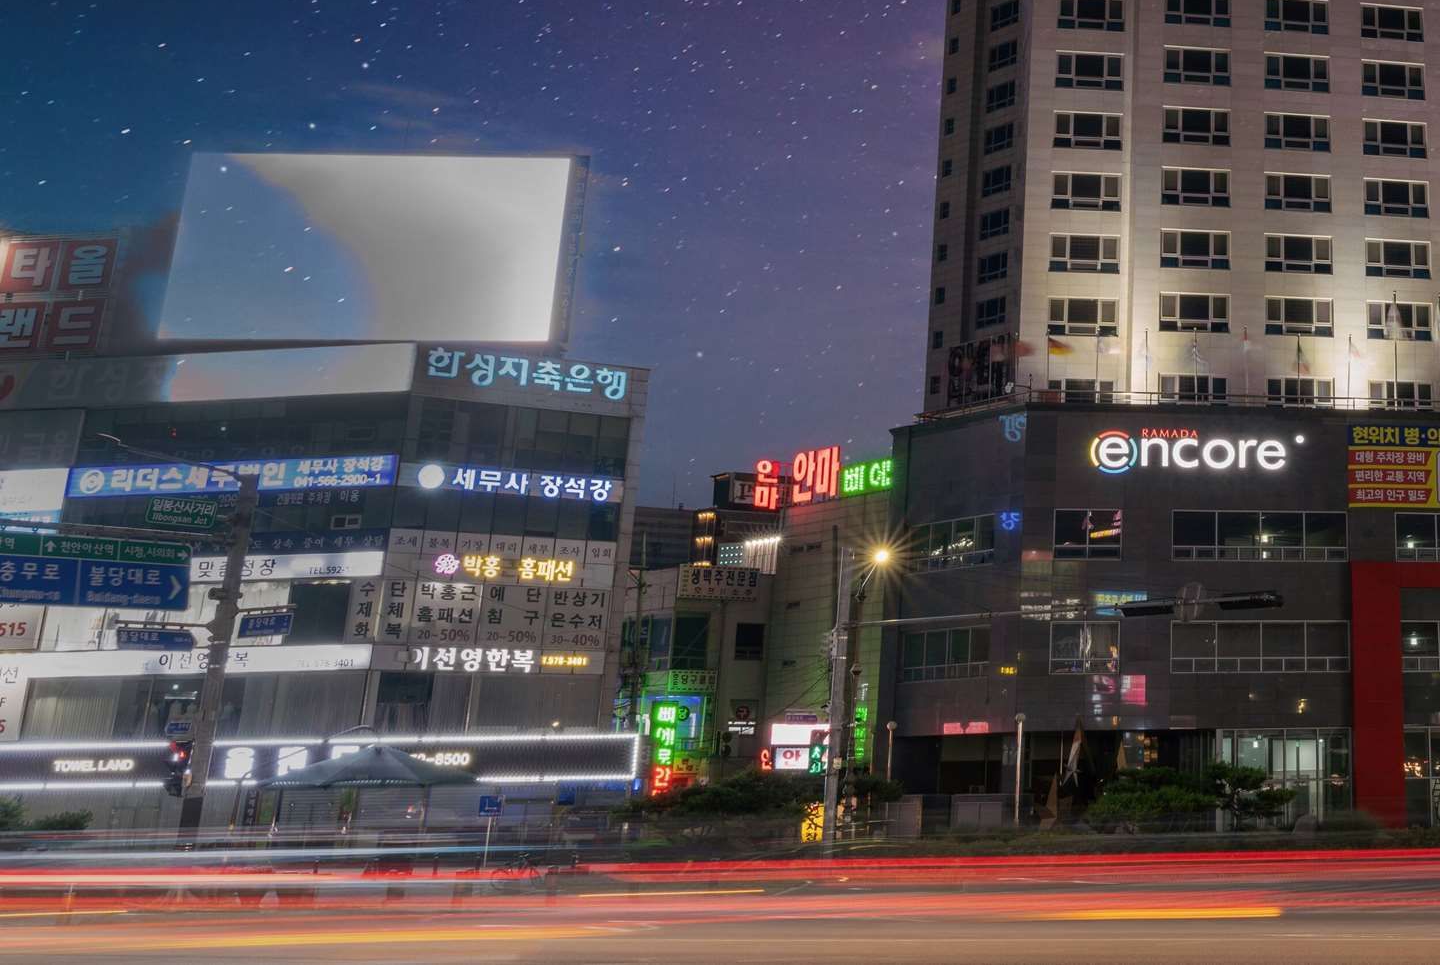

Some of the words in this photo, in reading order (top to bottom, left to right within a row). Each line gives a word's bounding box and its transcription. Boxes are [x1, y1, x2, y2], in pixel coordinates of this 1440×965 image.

[10, 244, 108, 287] 타올
[1141, 428, 1199, 438] RAMADA
[1352, 426, 1400, 444] 현위치
[1098, 435, 1287, 471] encore
[1355, 452, 1374, 463] 대형
[1376, 453, 1405, 464] 주차장
[1407, 453, 1426, 465] 완비
[452, 467, 529, 496] 세무사
[539, 474, 612, 502] 장석강
[793, 446, 841, 503] 안마
[1355, 471, 1384, 482] 편리한
[1386, 472, 1405, 483] 교통
[1408, 472, 1426, 484] 지역
[152, 498, 216, 516] 일봉산사거리
[1355, 490, 1384, 501] 최고의
[1387, 490, 1406, 502] 인구
[1409, 490, 1427, 502] 밀도
[0, 561, 61, 582] 충무로
[89, 565, 161, 586] 불당대로
[518, 558, 573, 582] 홈패션
[420, 583, 477, 601] 박홍근
[554, 591, 605, 607] 반상기
[416, 606, 474, 624] 홈패션
[551, 611, 602, 630] 은수저
[159, 650, 250, 670] 이선영복
[53, 759, 97, 773] TOWEL
[97, 758, 134, 772] LAND
